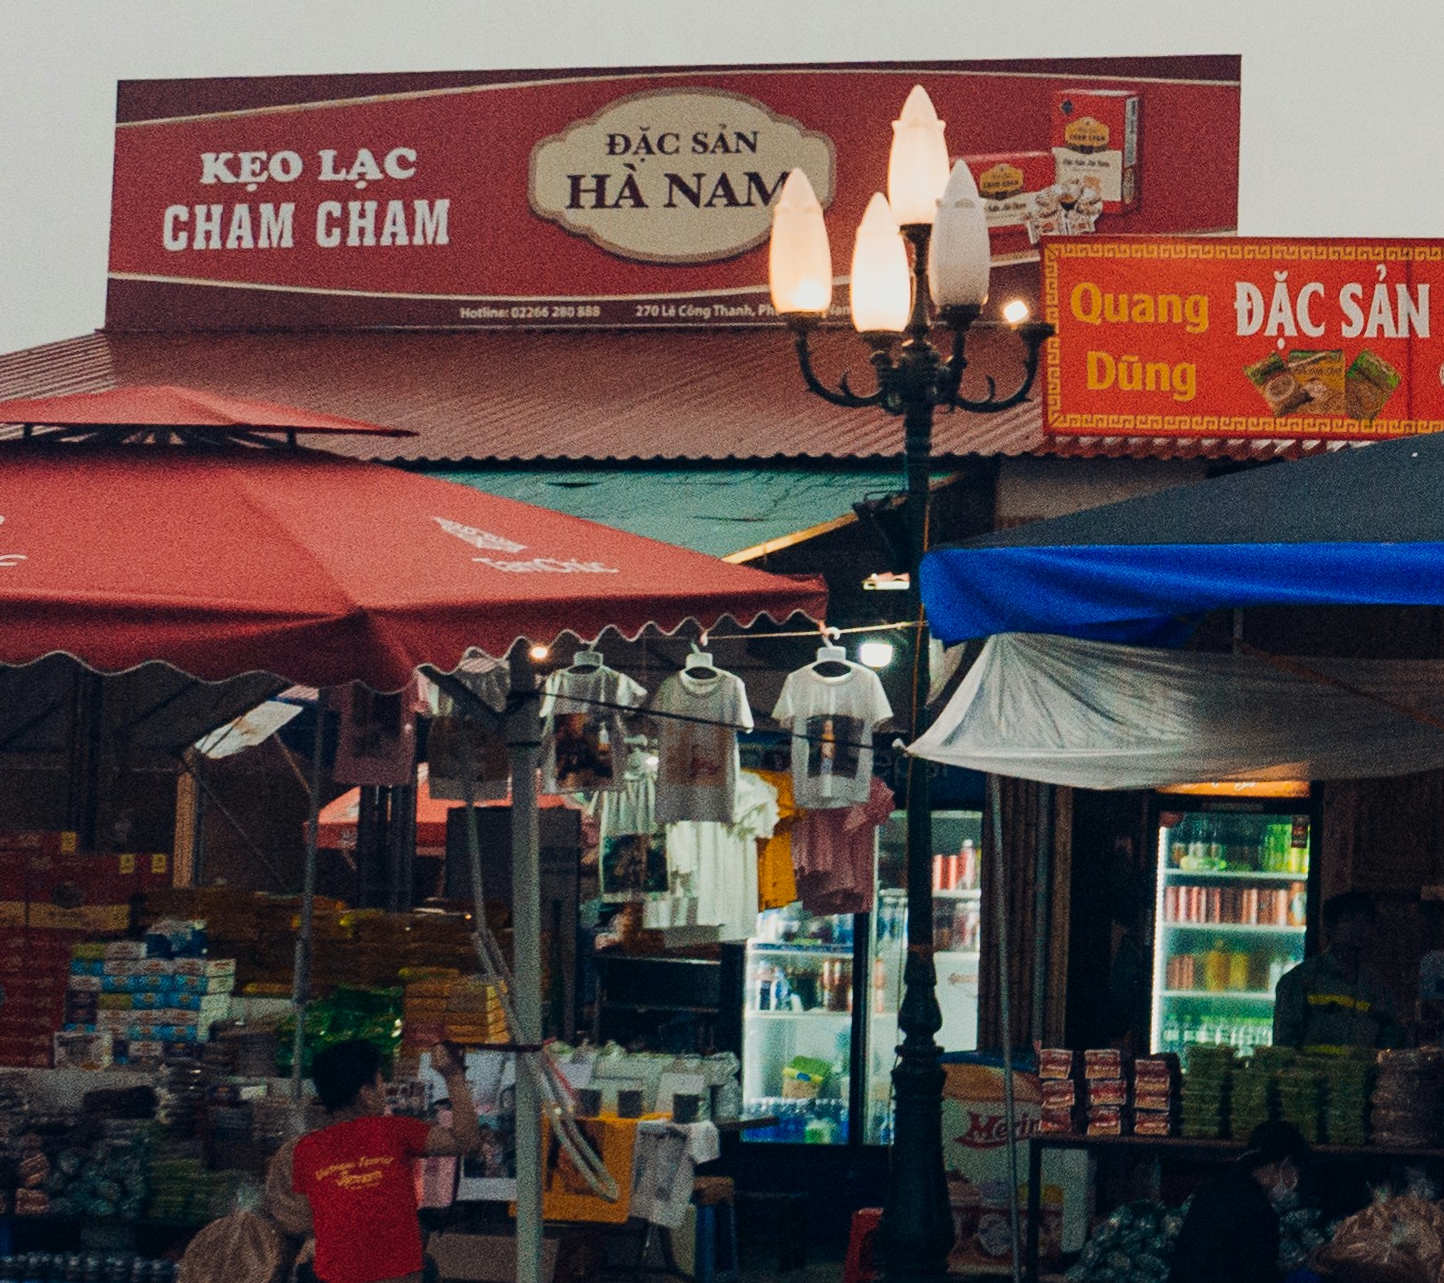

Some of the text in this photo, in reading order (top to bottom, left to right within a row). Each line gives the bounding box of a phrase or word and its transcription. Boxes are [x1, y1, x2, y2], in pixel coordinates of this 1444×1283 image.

[606, 124, 760, 163] ĐẶC SẢN
[199, 147, 418, 192] KẸO LẠC
[566, 163, 791, 210] HÀ NAM
[162, 198, 451, 252] CHAM CHAM
[1070, 281, 1209, 334] Quang
[1235, 270, 1326, 349] ĐẶC
[1341, 264, 1431, 339] SẢN
[1086, 349, 1197, 400] Dũng
